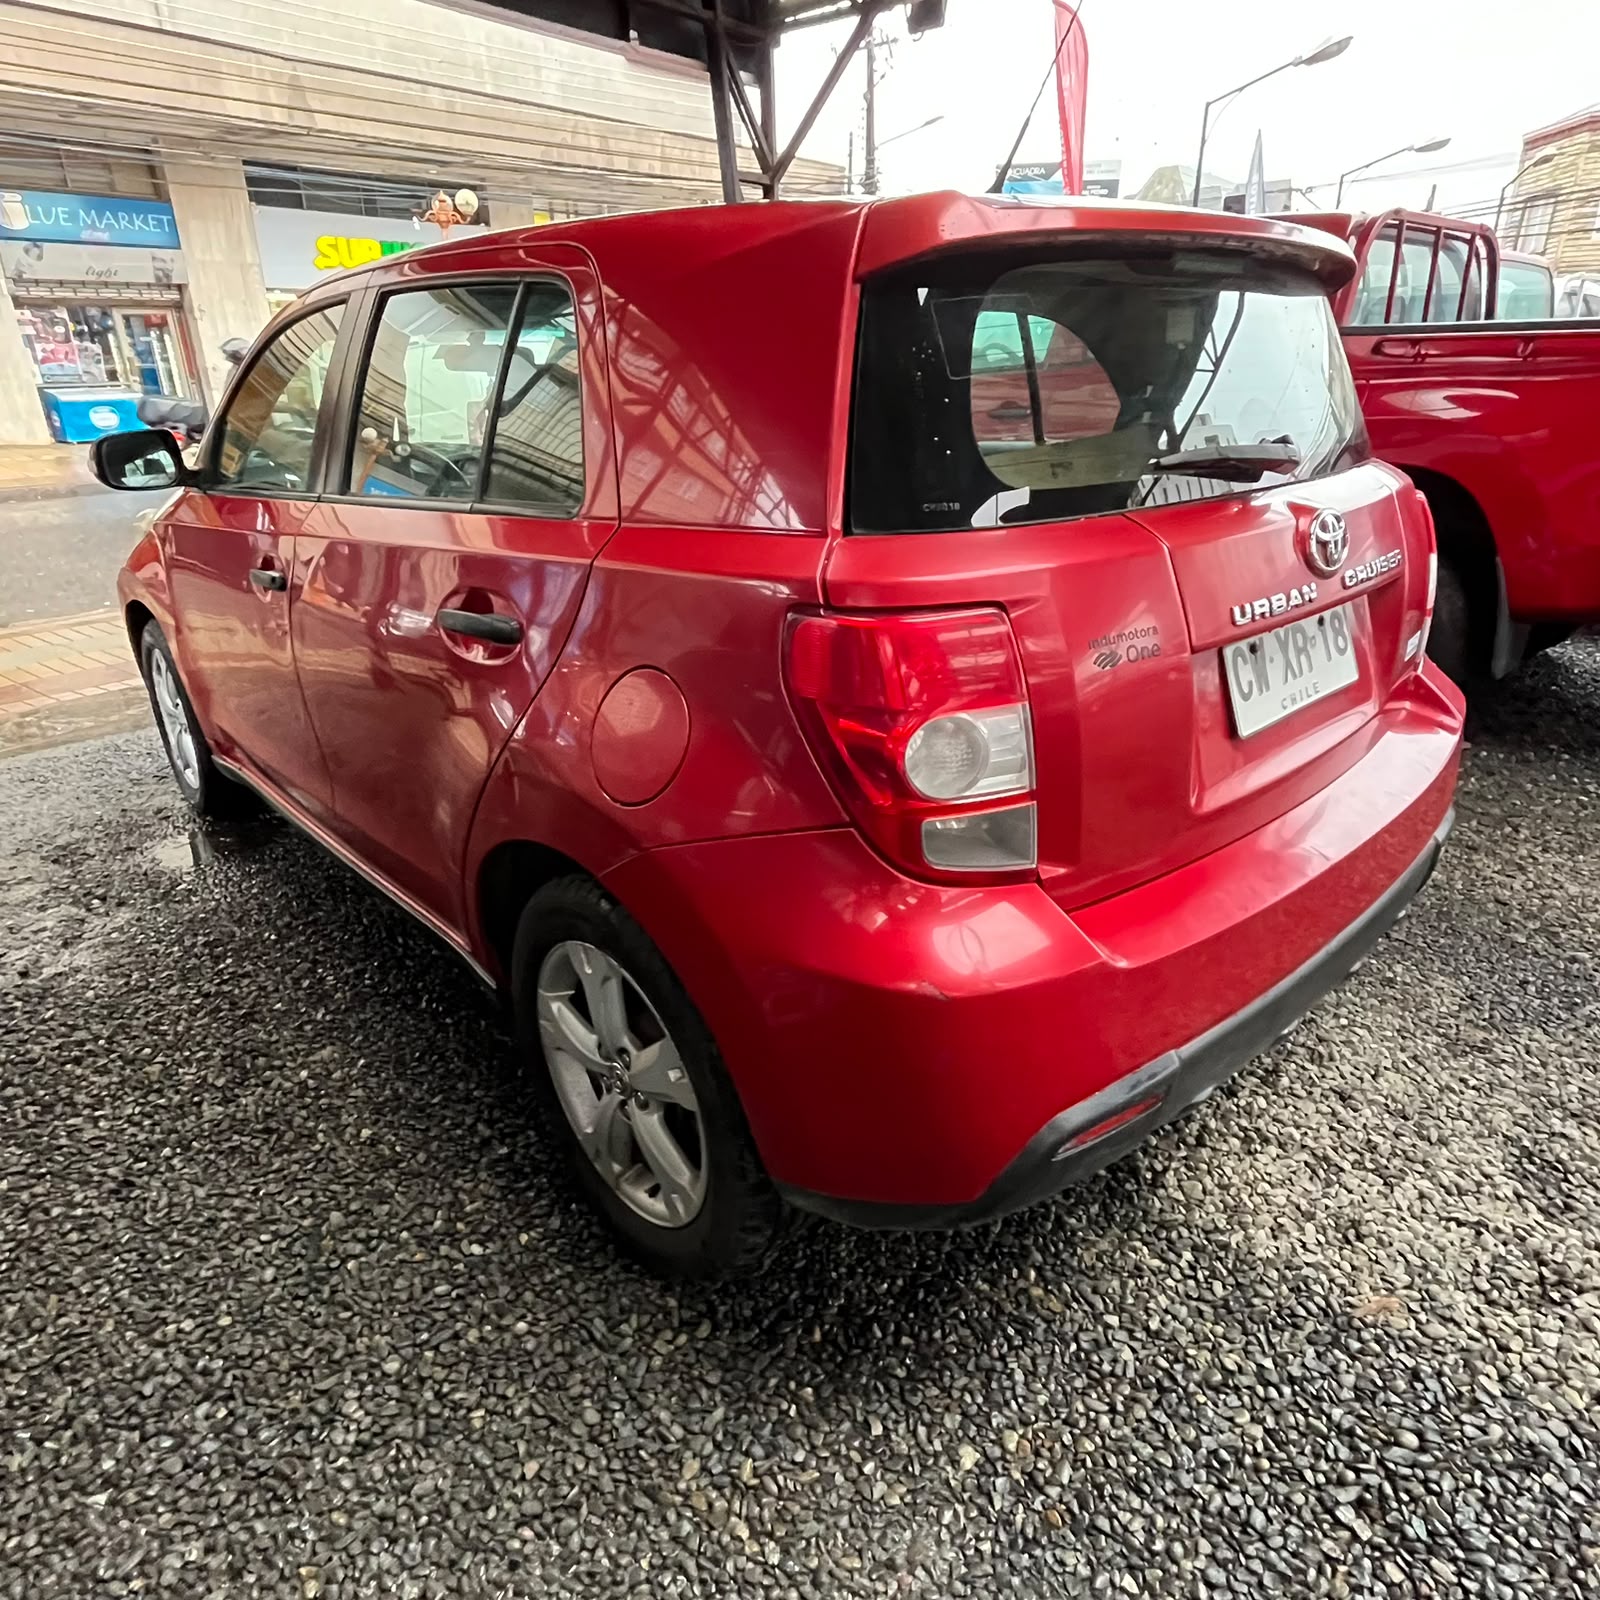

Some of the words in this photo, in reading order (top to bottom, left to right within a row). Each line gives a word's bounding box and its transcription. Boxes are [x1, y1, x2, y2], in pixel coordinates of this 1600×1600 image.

[79, 208, 172, 233] MARKET
[313, 235, 427, 269] SUB
[1231, 582, 1318, 625] URBAN
[1343, 549, 1402, 589] CRUISER
[1126, 643, 1161, 663] One
[1281, 681, 1321, 710] CHILE
